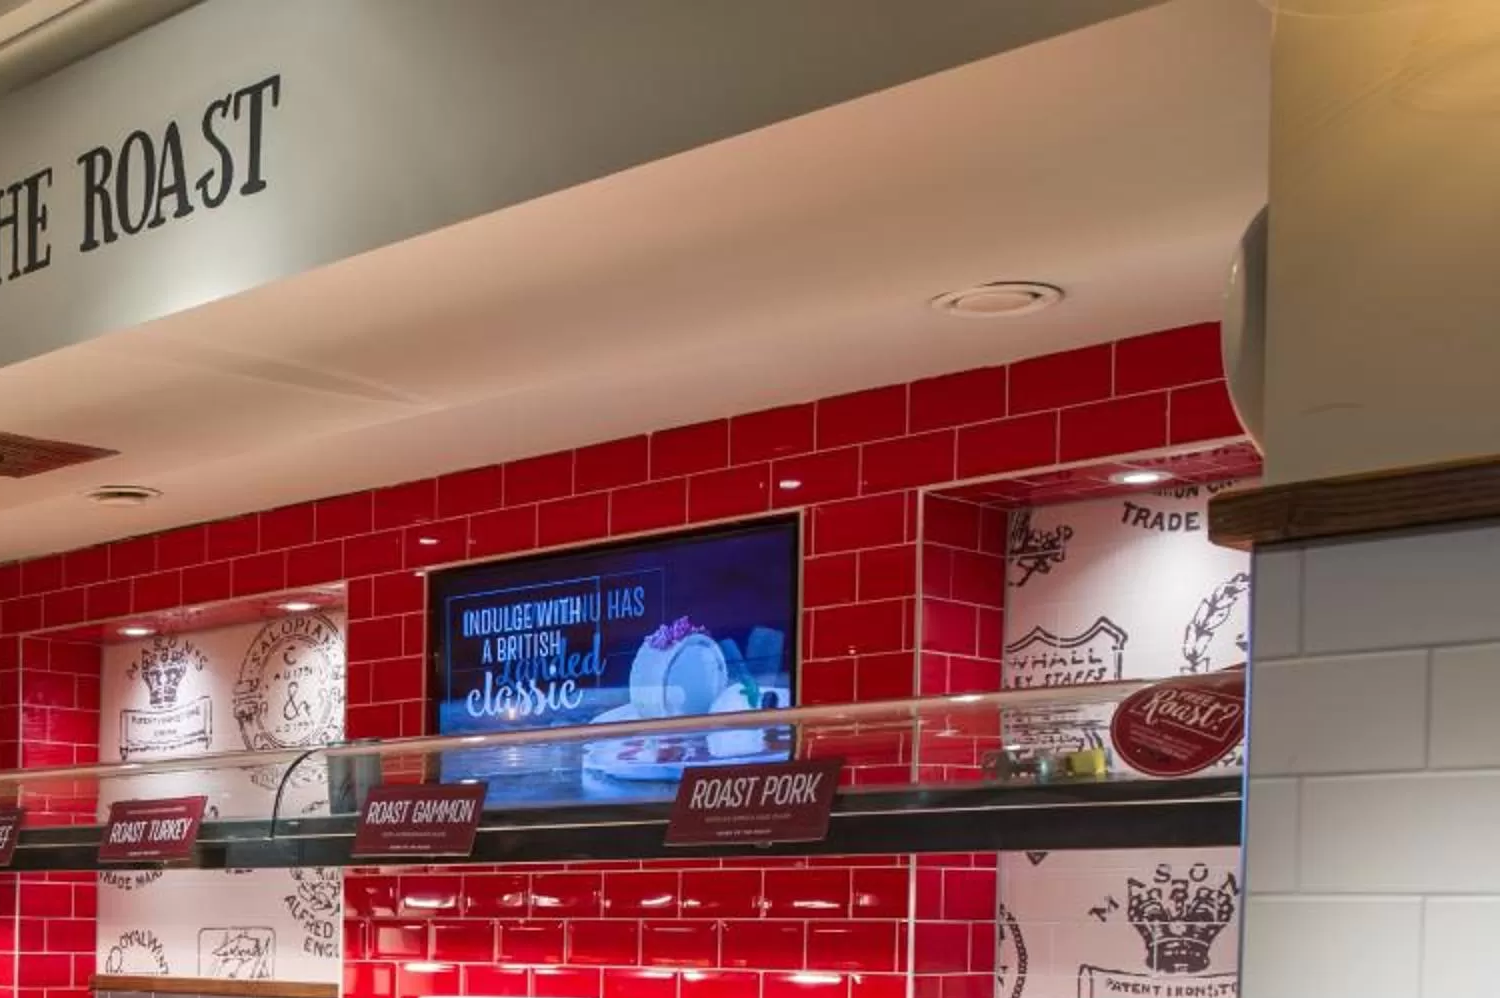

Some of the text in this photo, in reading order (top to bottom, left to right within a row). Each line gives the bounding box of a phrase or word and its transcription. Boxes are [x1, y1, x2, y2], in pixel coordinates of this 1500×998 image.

[76, 73, 282, 253] ROAST
[1120, 500, 1201, 533] TRADE
[462, 602, 533, 638] INDULGE
[534, 596, 582, 628] WITH
[606, 585, 646, 621] HAS
[480, 629, 562, 665] A BRITISH
[465, 664, 585, 718] classic
[688, 771, 825, 810] ROAST PORK
[364, 799, 477, 825] ROAST GAMMON
[108, 816, 194, 845] ROAST TURKEY
[1105, 977, 1163, 997] PATENT
